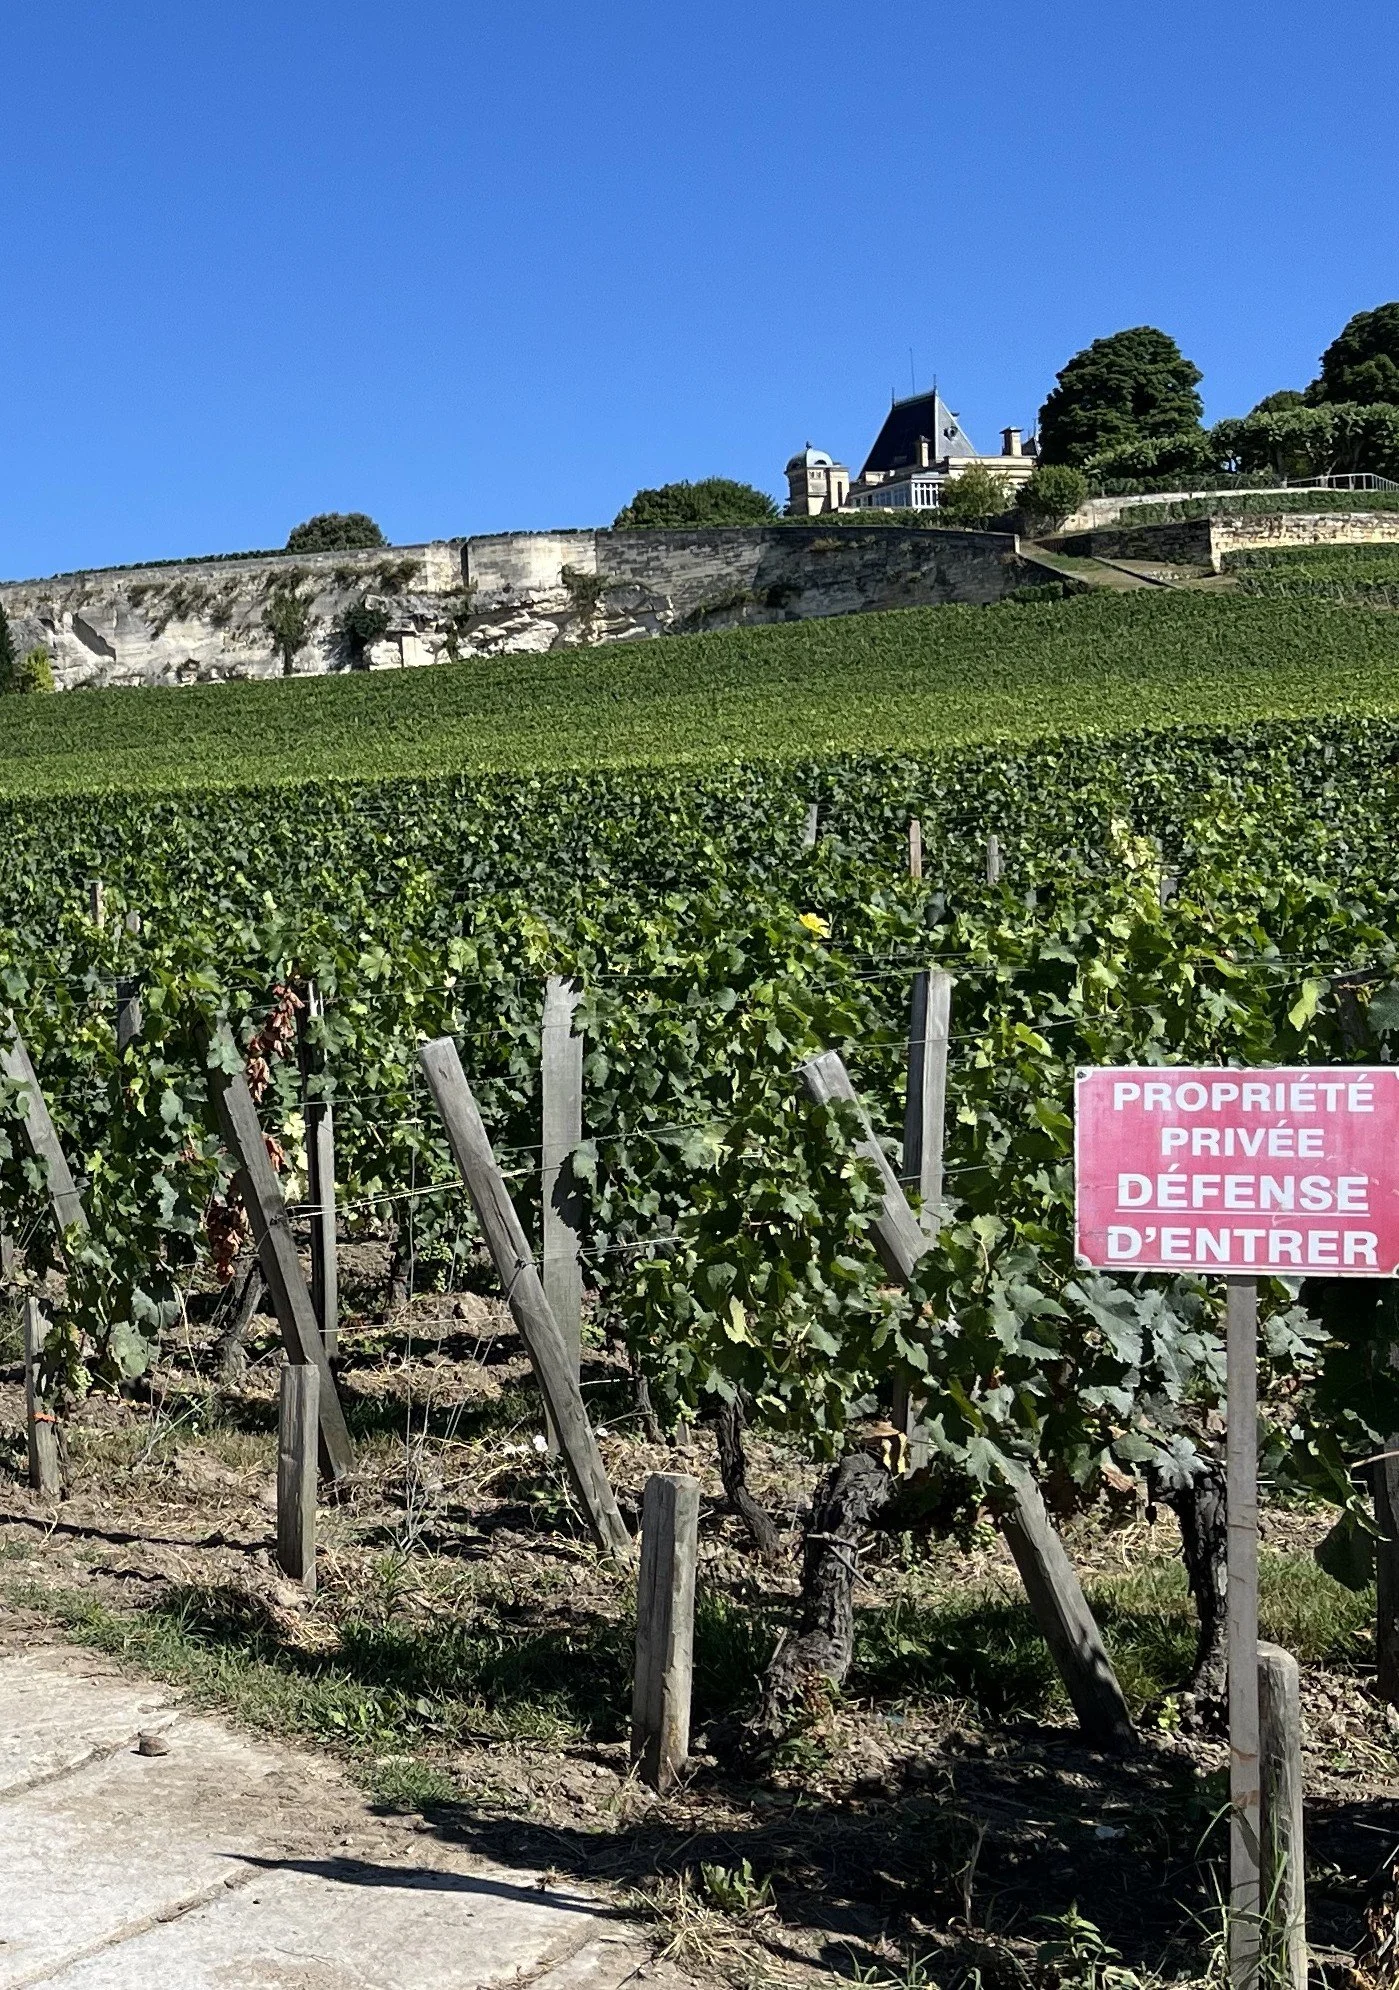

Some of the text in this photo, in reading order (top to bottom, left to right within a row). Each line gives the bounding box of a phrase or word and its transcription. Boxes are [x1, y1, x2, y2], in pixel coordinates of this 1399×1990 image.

[1113, 1073, 1375, 1112] PROPRIÉTÉ
[1161, 1119, 1325, 1158] PRIVÉE
[1117, 1164, 1370, 1211] DÉFENSE
[1107, 1225, 1378, 1265] D'ENTRER
